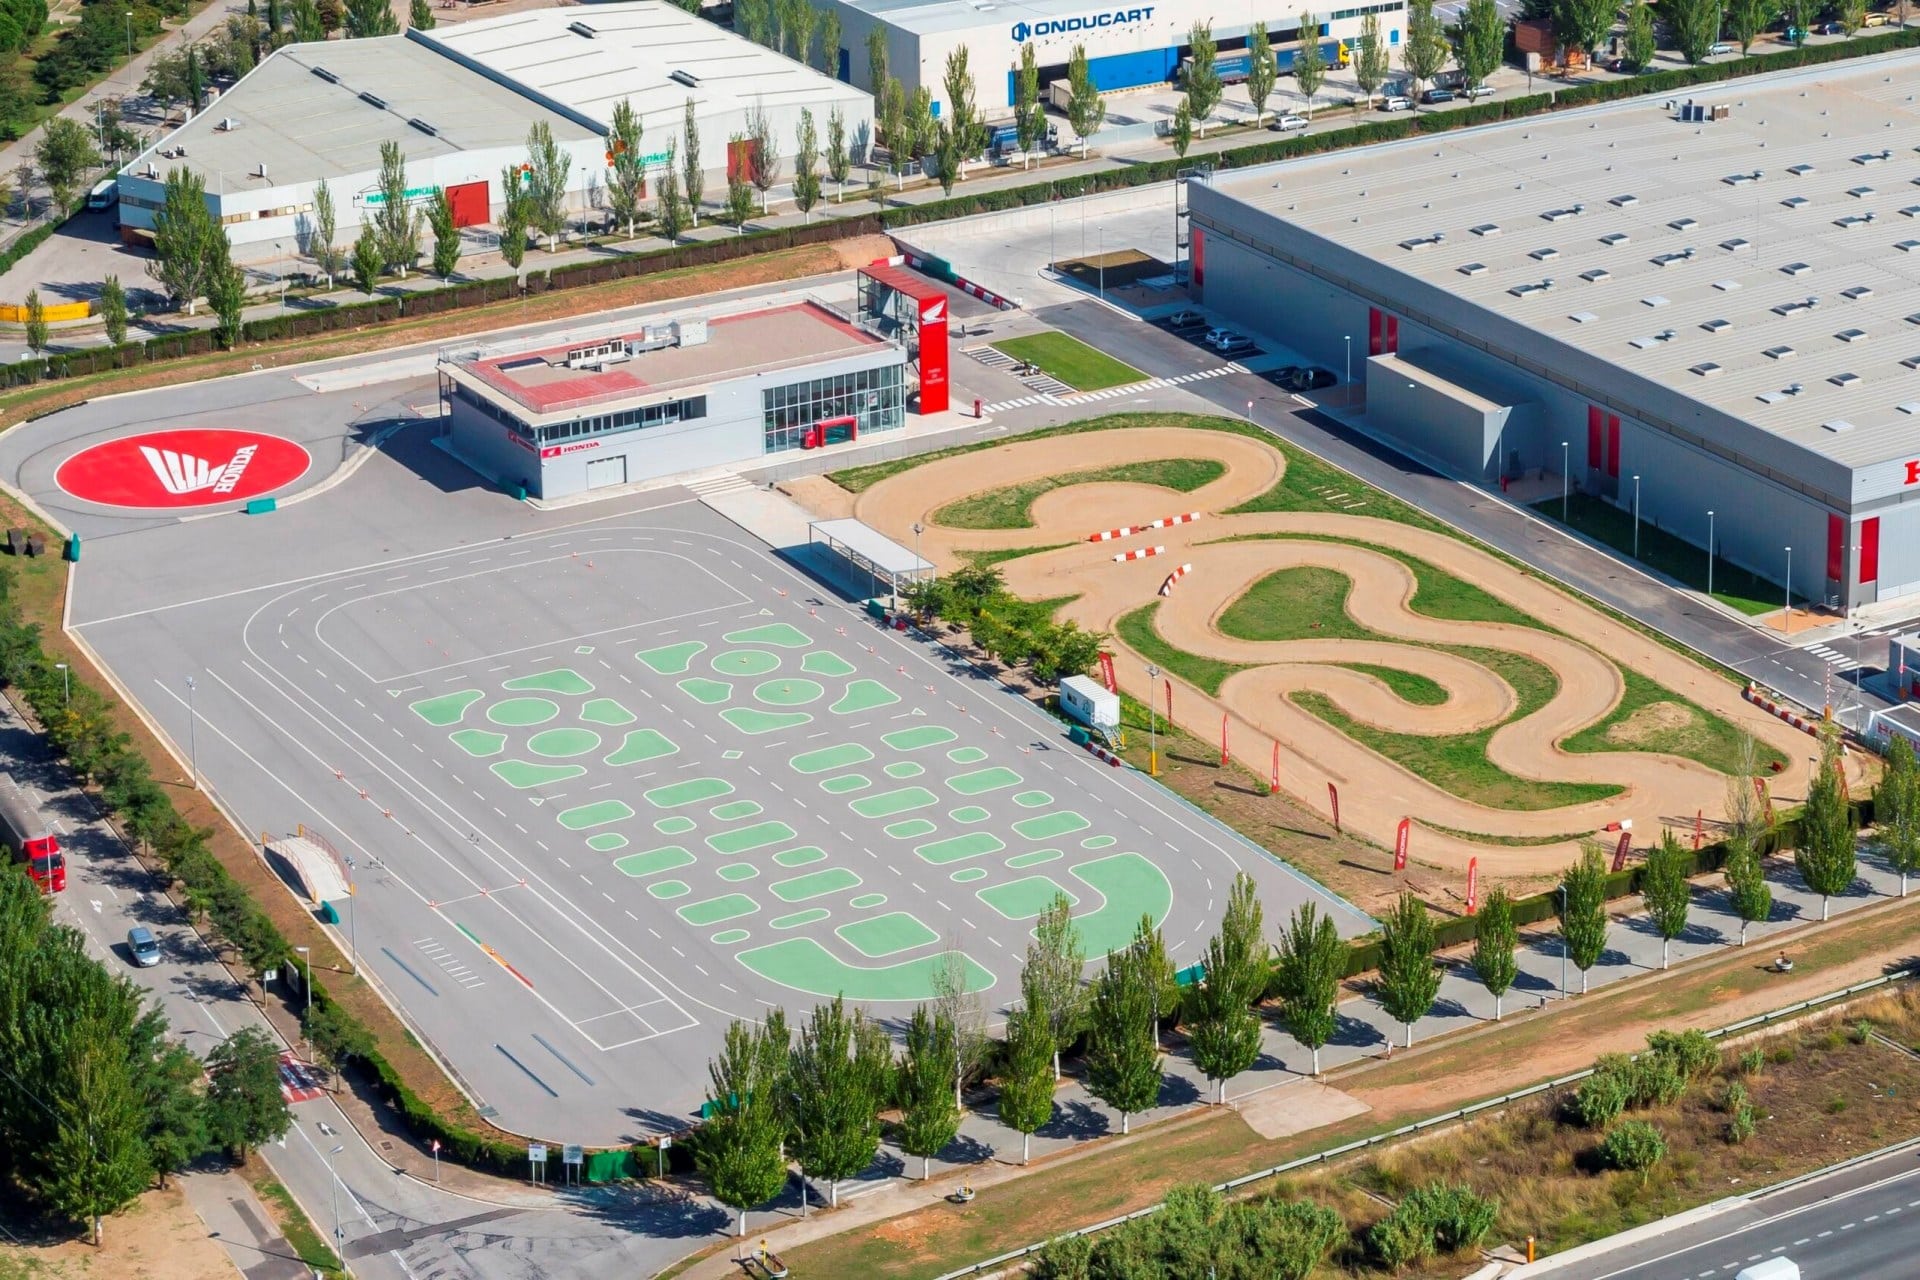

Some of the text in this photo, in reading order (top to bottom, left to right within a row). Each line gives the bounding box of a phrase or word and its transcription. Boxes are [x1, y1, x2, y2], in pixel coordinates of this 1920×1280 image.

[1035, 7, 1155, 35] ONDUCART
[563, 442, 600, 452] HONDA
[213, 444, 258, 493] HONDA
